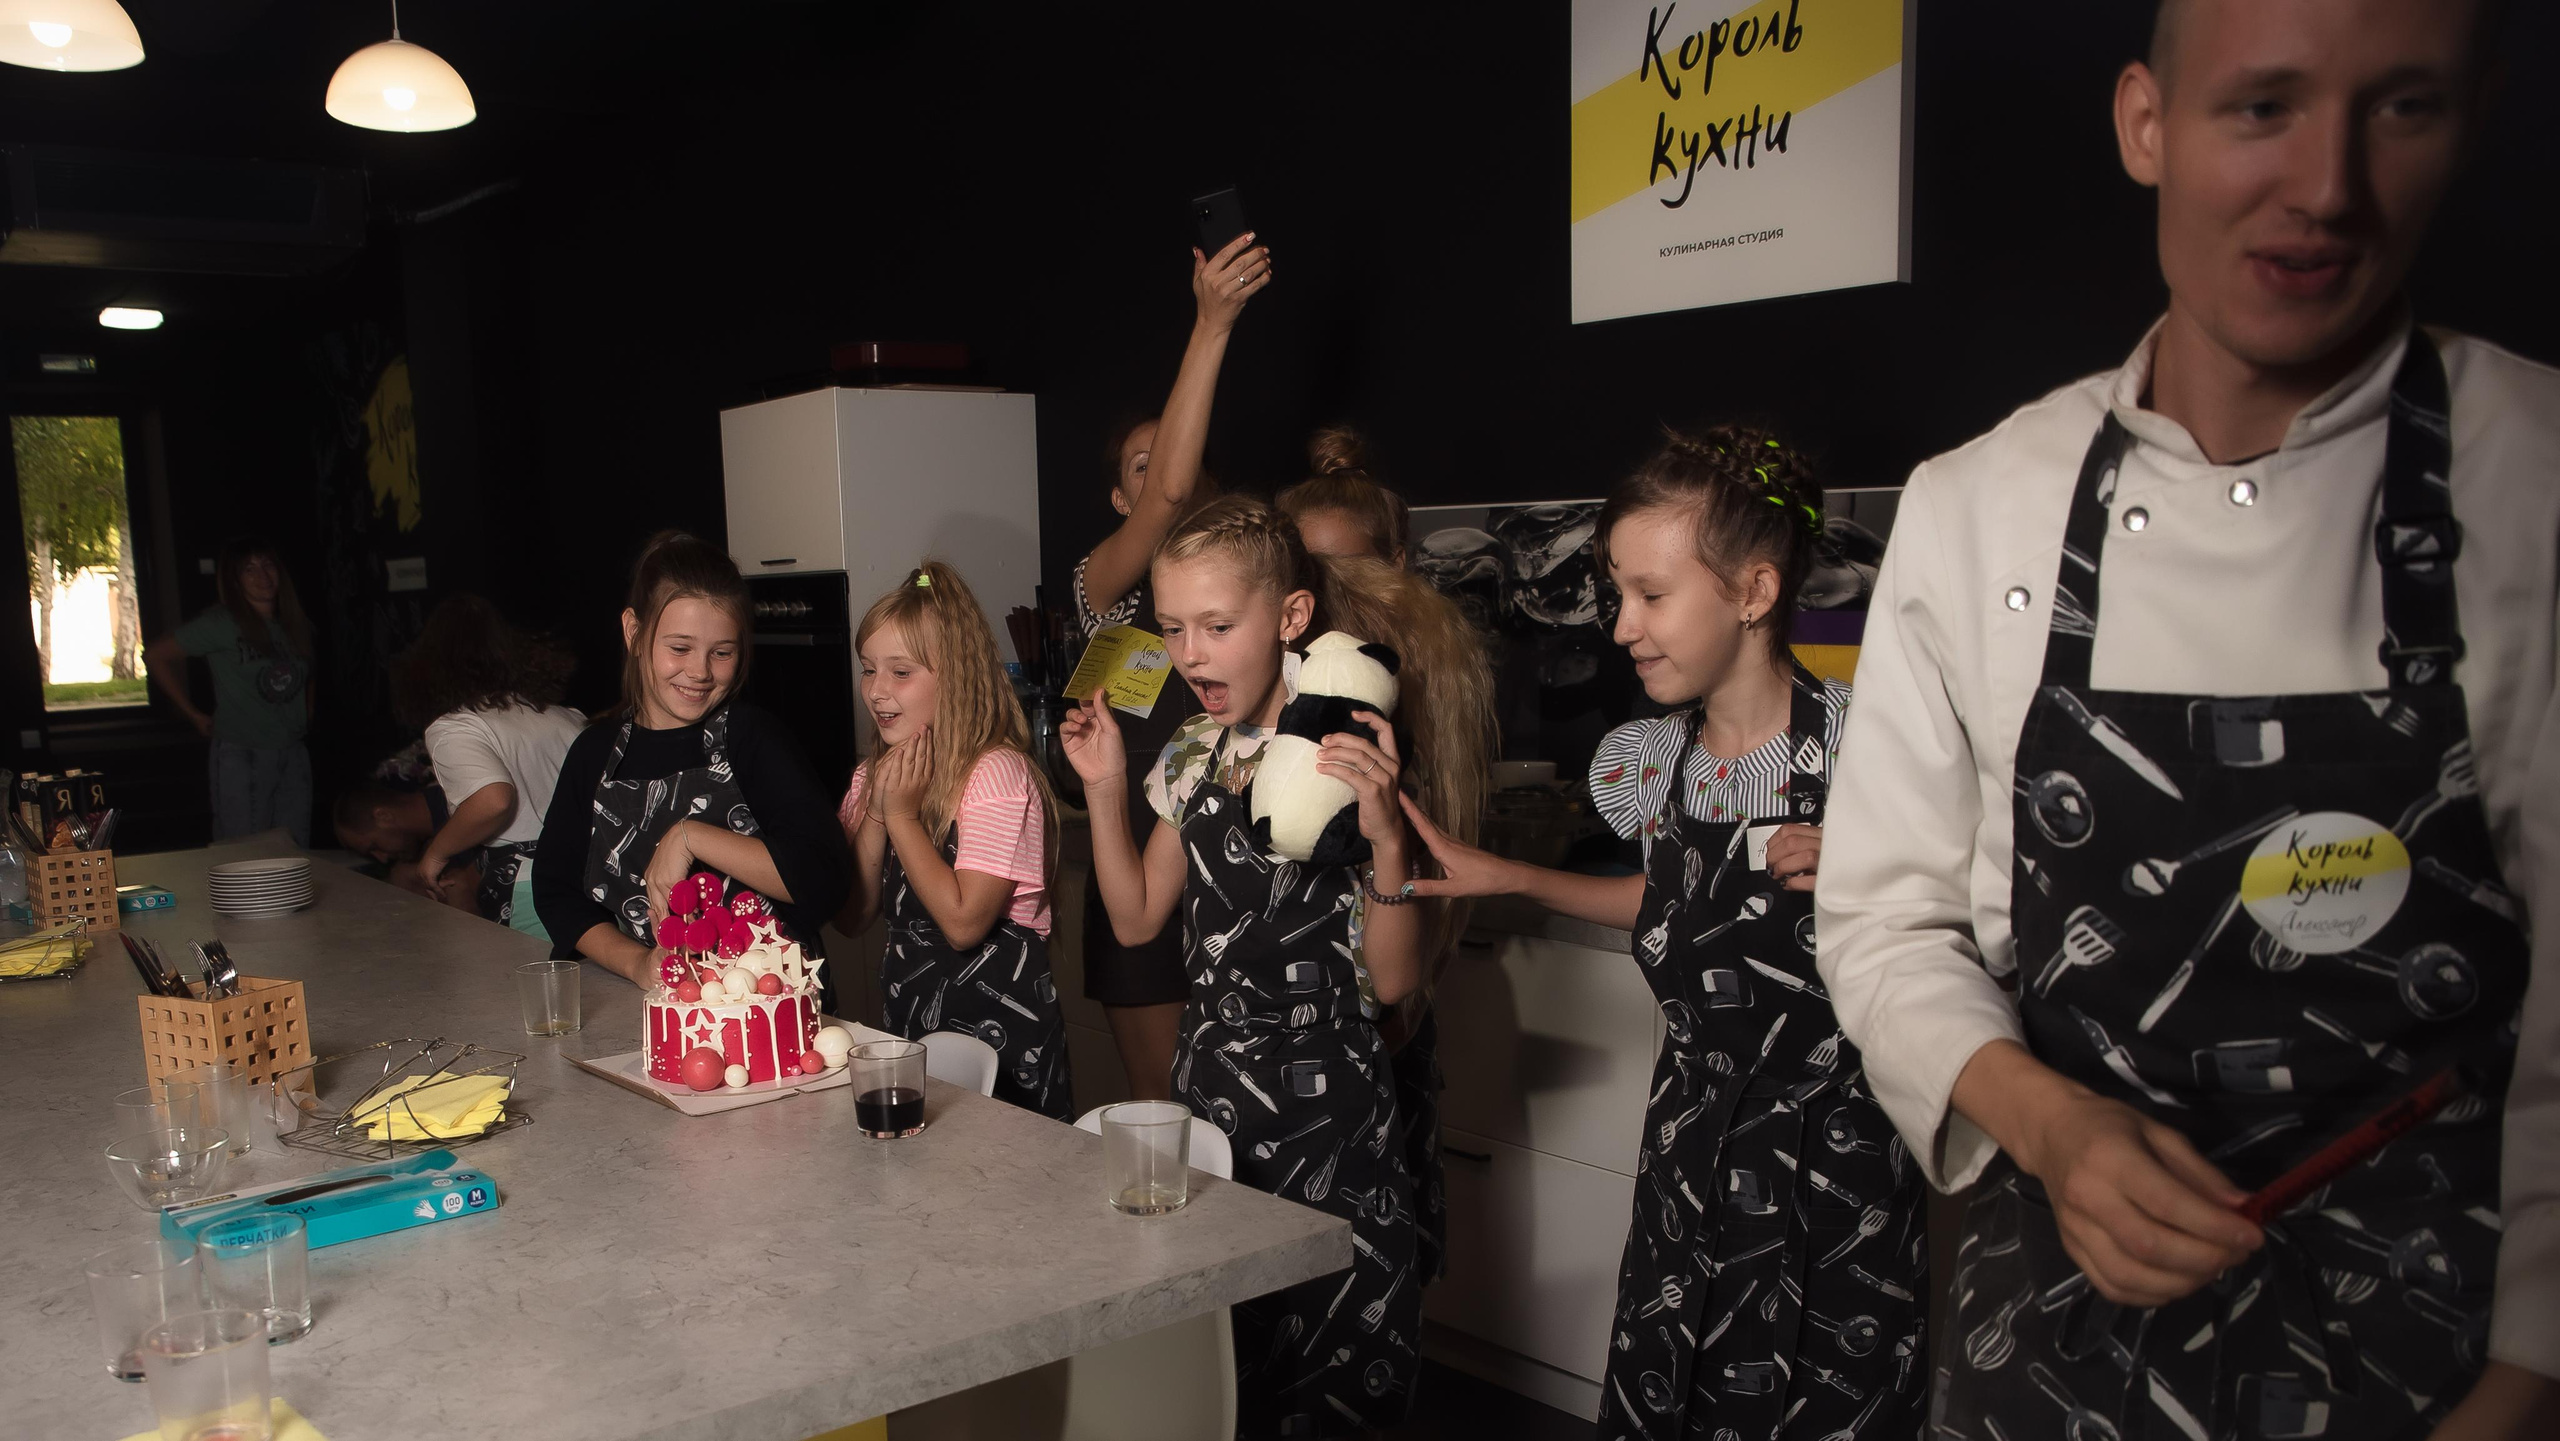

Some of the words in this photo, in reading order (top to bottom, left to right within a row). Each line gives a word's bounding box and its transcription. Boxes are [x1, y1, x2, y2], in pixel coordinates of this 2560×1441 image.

[1640, 0, 1803, 101] Король
[1659, 236, 1735, 258] КУЛИНАРНАЯ
[1737, 228, 1784, 246] СТУДИЯ
[57, 789, 73, 812] Я
[91, 784, 105, 806] Я
[2287, 830, 2374, 868] Король
[445, 1196, 461, 1207] 100
[219, 1224, 289, 1247] ПЕРЧАТКИ
